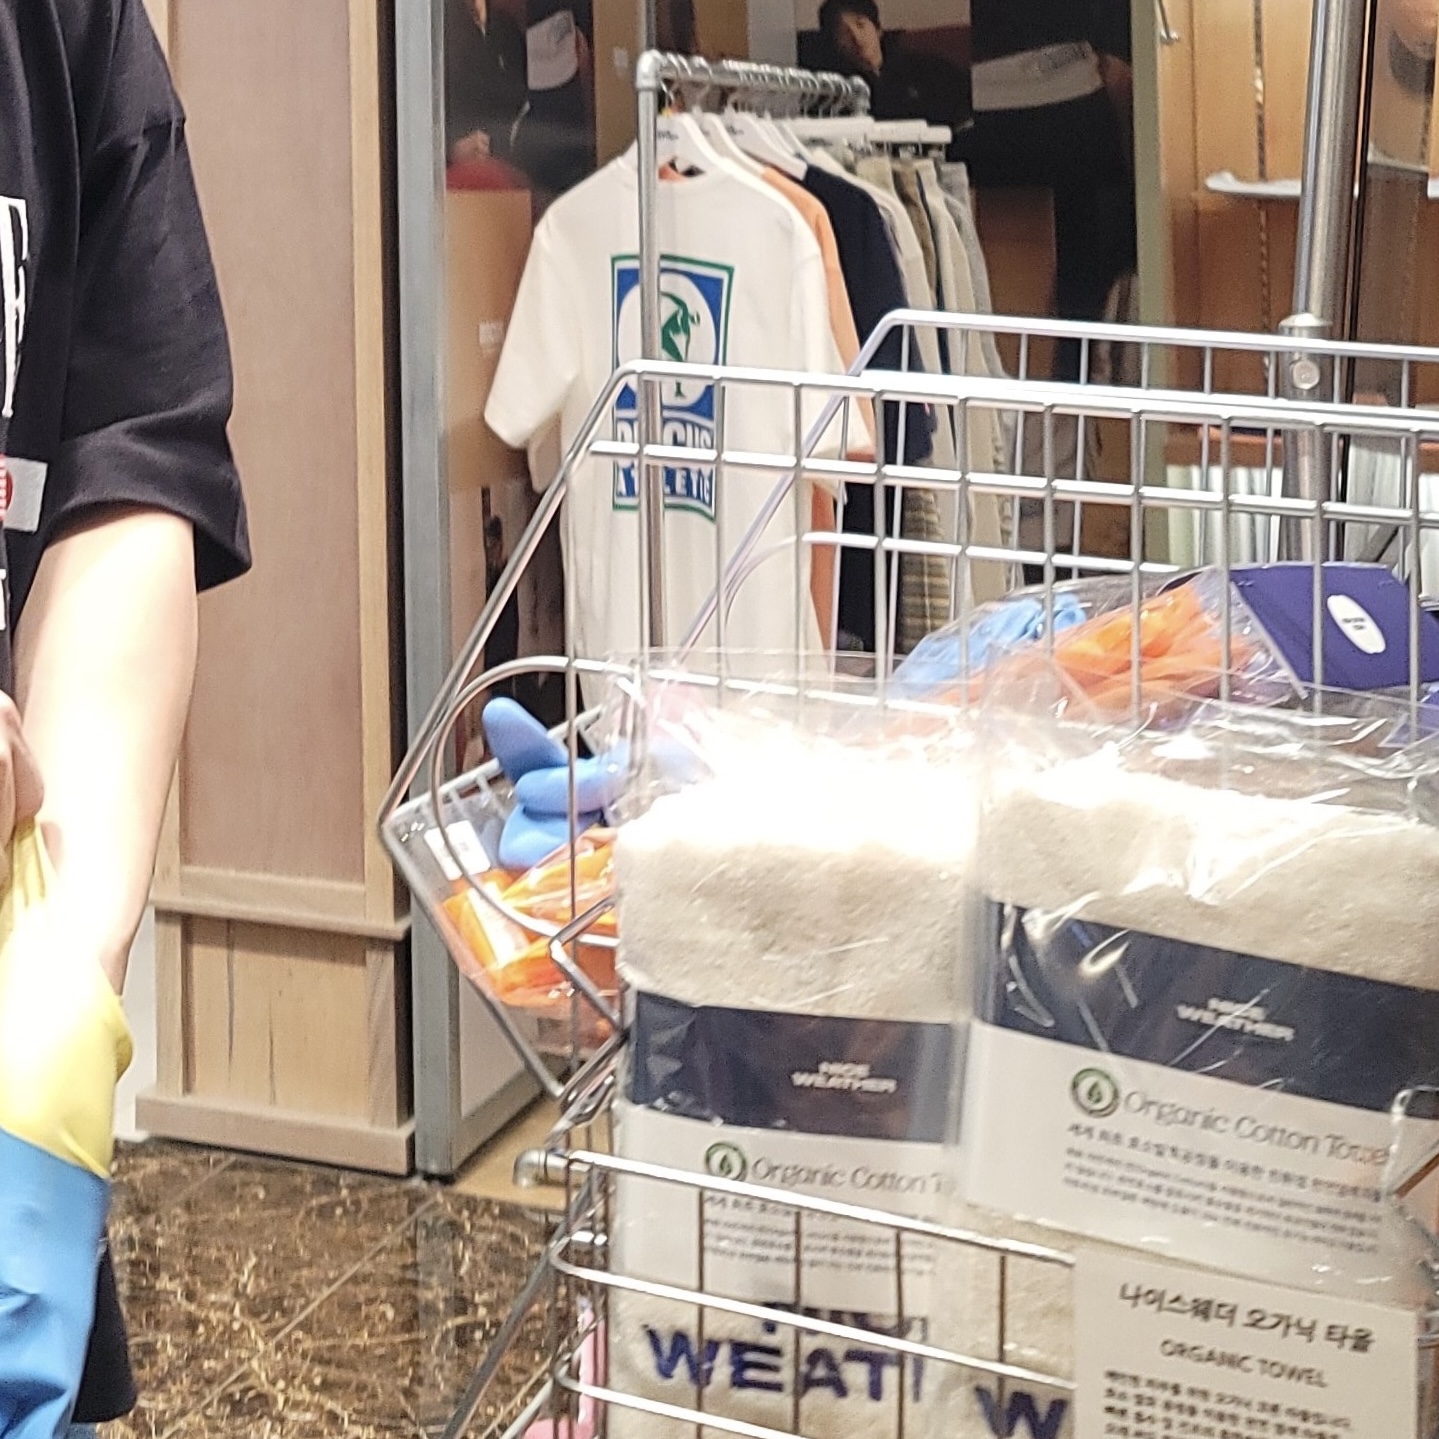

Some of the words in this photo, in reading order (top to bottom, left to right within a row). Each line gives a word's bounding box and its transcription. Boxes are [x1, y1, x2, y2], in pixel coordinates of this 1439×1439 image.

[1123, 1090, 1229, 1134] Organic
[1233, 1115, 1319, 1155] Cotton
[751, 1156, 846, 1189] Organic
[850, 1166, 926, 1194] Cotton
[1243, 1308, 1318, 1344] 오가닉
[1160, 1338, 1254, 1374] ORGANIC
[1258, 1358, 1330, 1389] TOWEL
